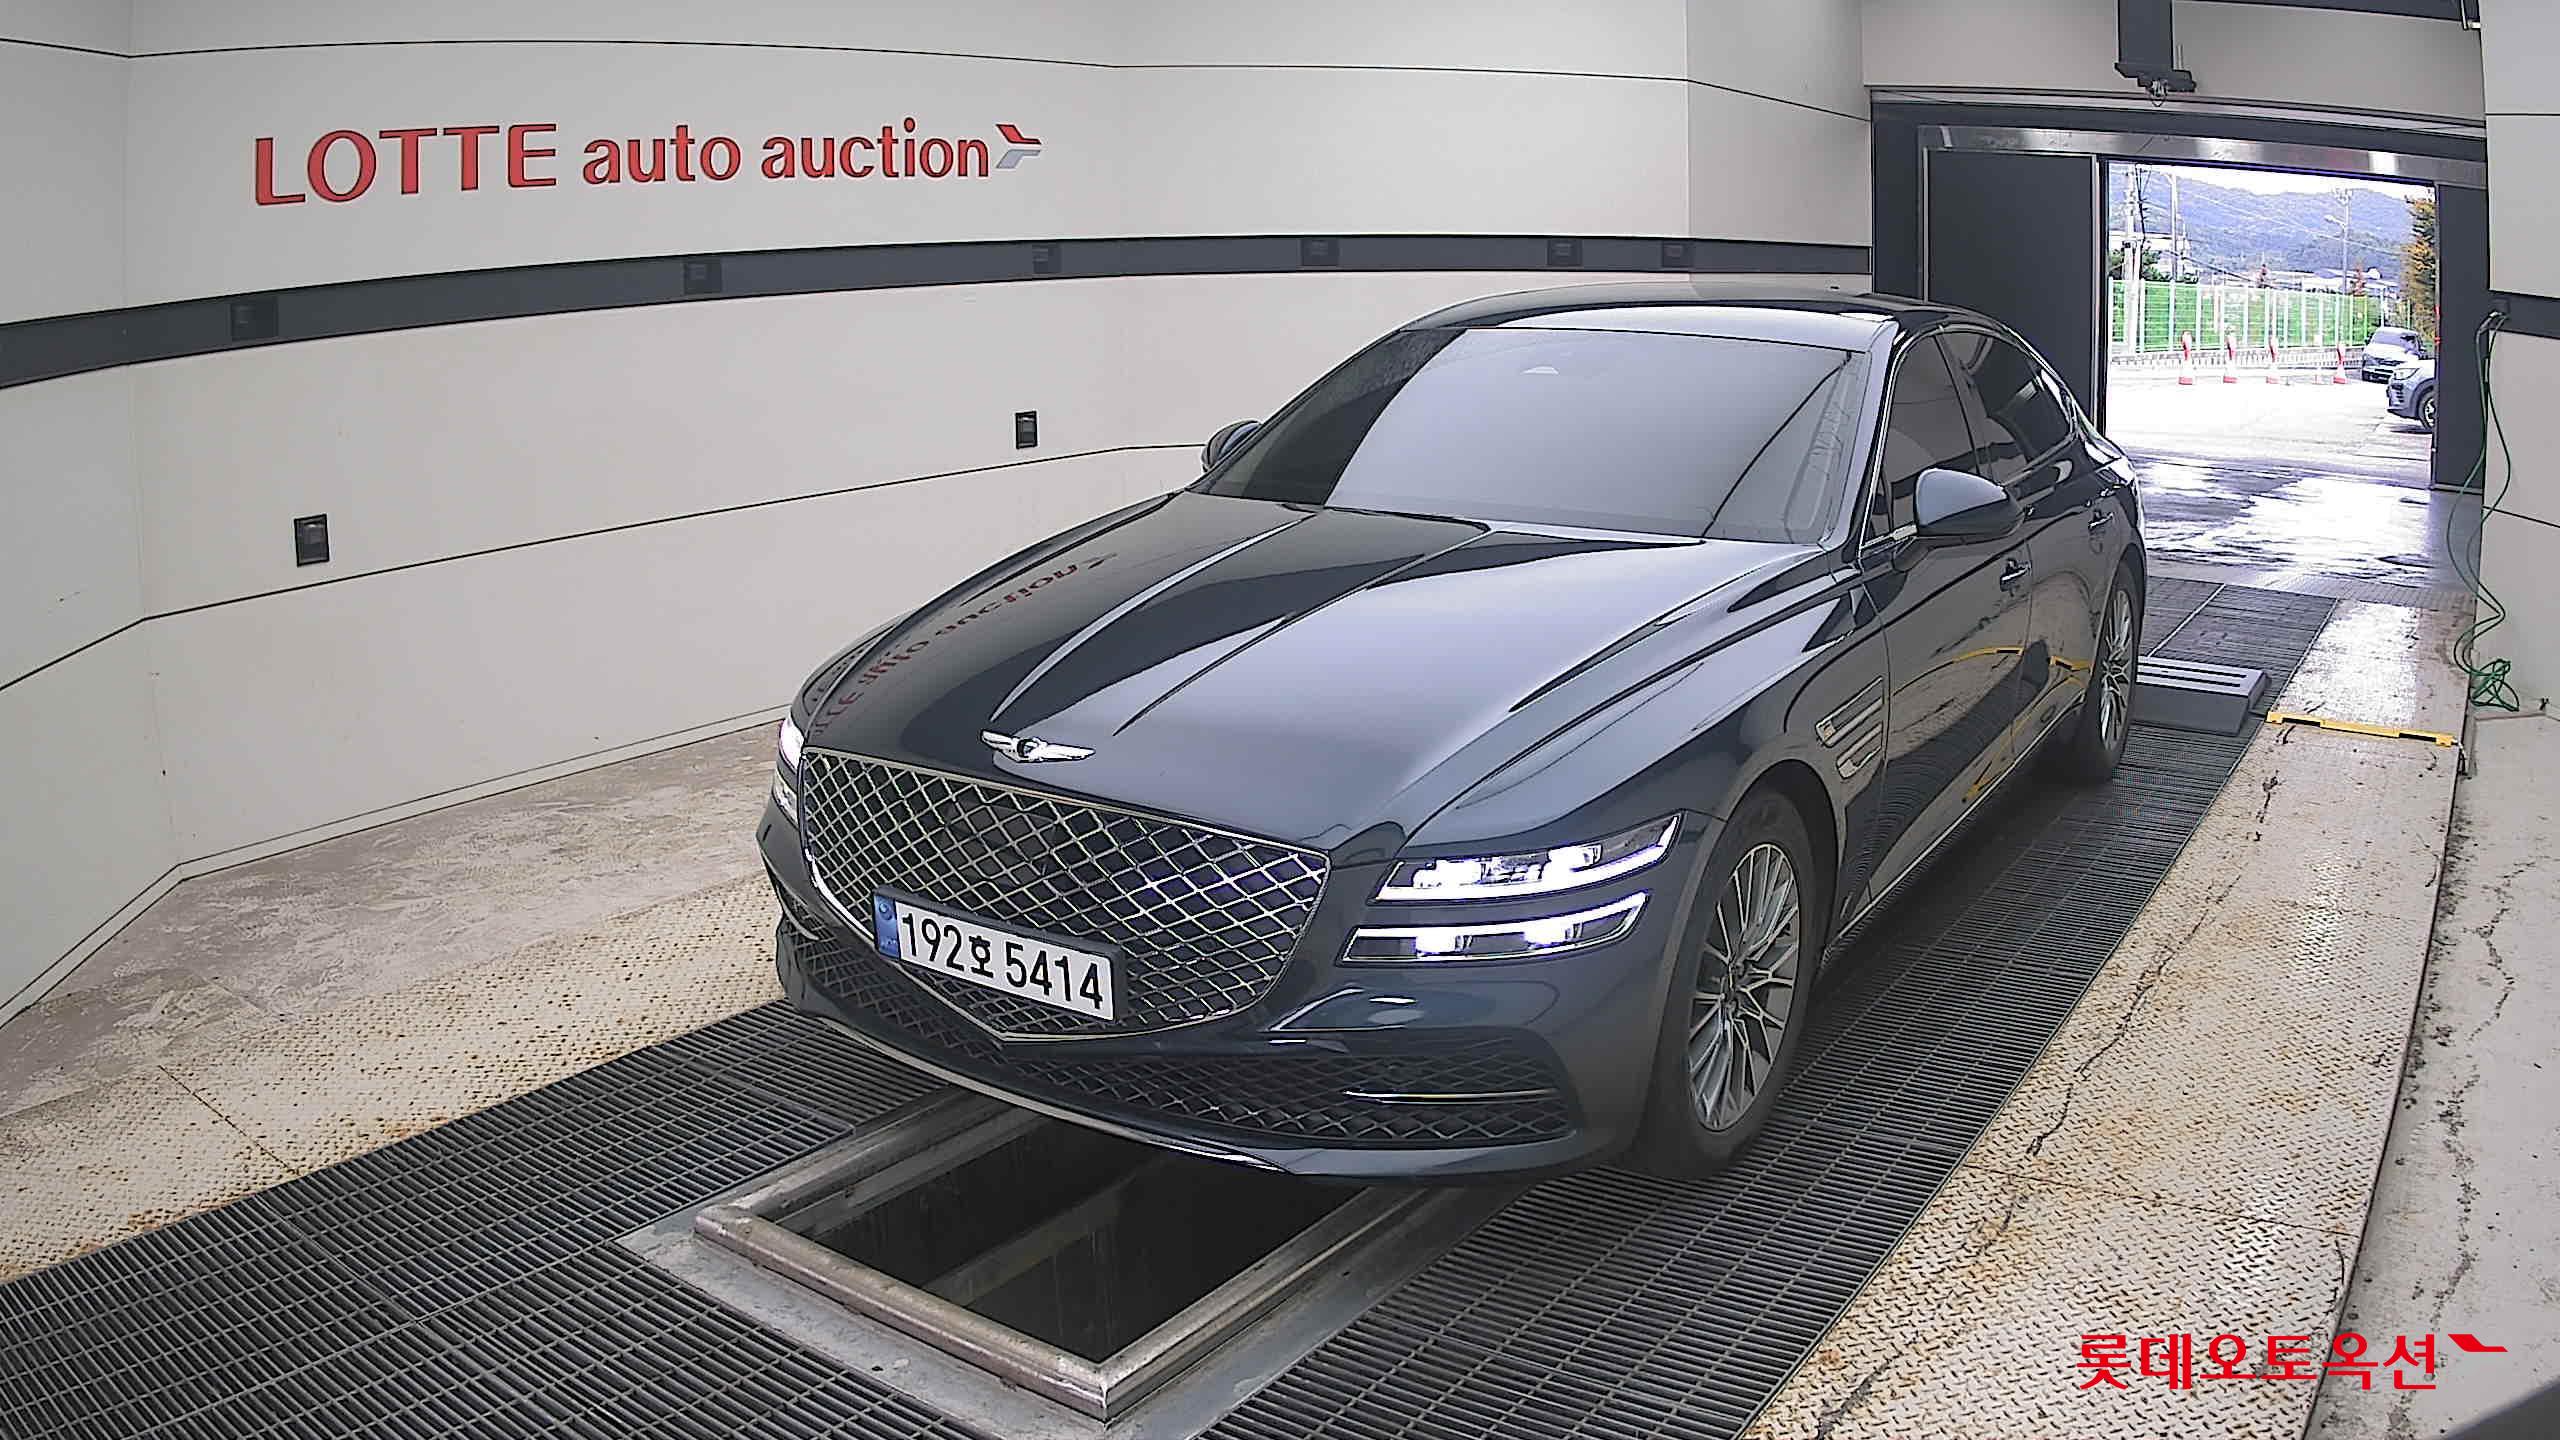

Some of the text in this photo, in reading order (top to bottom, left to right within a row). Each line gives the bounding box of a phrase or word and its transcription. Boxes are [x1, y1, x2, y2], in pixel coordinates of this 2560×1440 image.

[254, 118, 990, 206] LOTTE auto auction
[902, 913, 1103, 1010] 192호 5414
